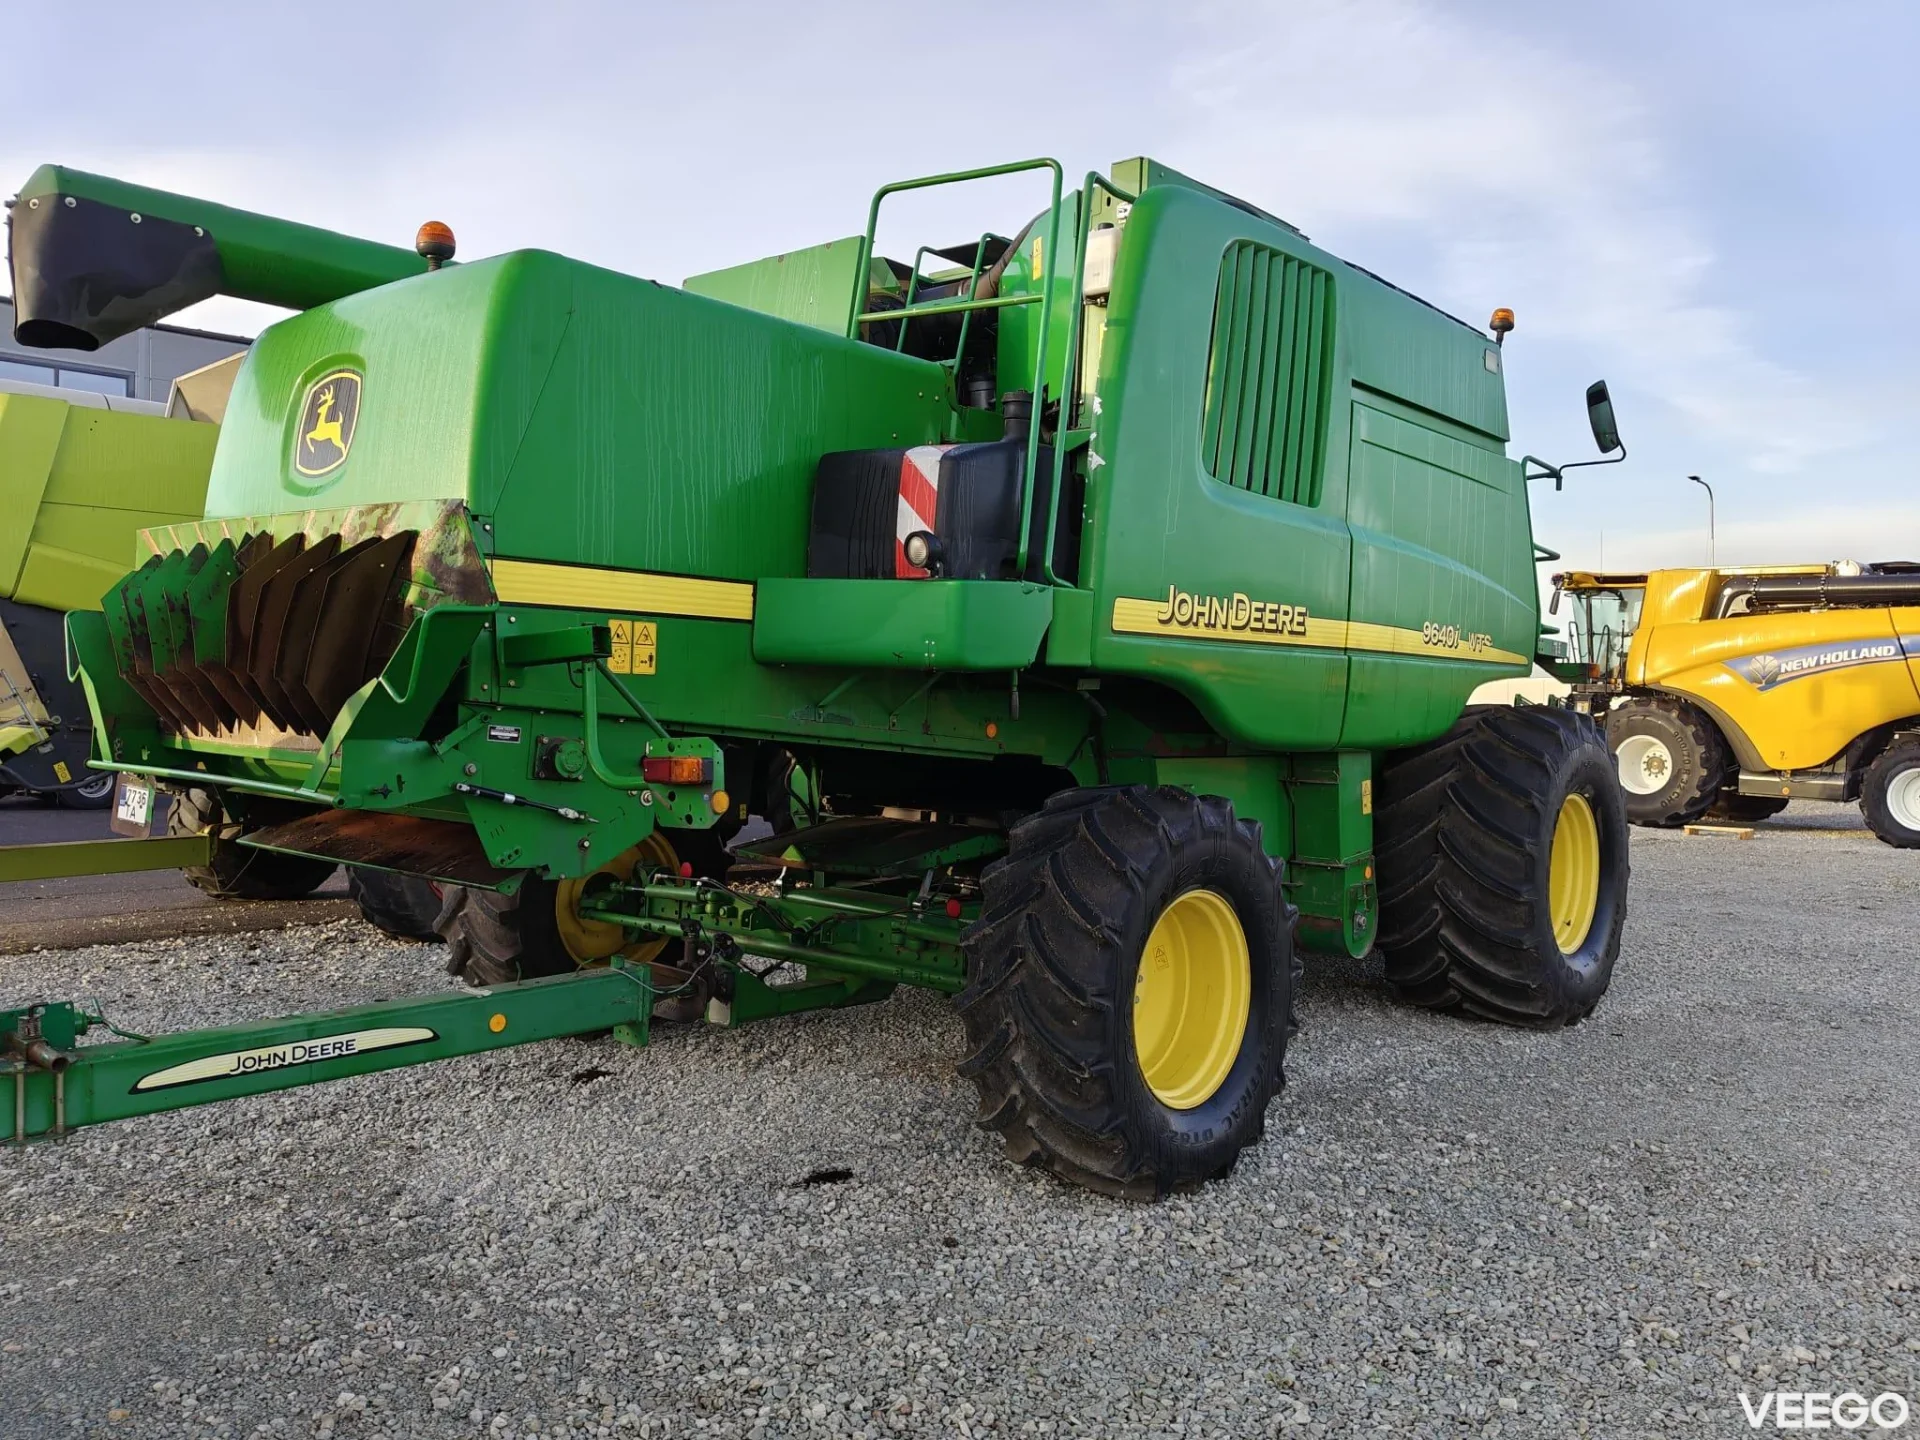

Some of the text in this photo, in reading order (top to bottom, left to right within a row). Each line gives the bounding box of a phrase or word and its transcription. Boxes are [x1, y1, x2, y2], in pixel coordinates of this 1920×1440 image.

[1158, 584, 1308, 636] JOHN DEERE
[1422, 621, 1461, 649] 9640i
[1780, 645, 1896, 674] NEW HOLLAND
[229, 1038, 357, 1072] JOHN DEERE
